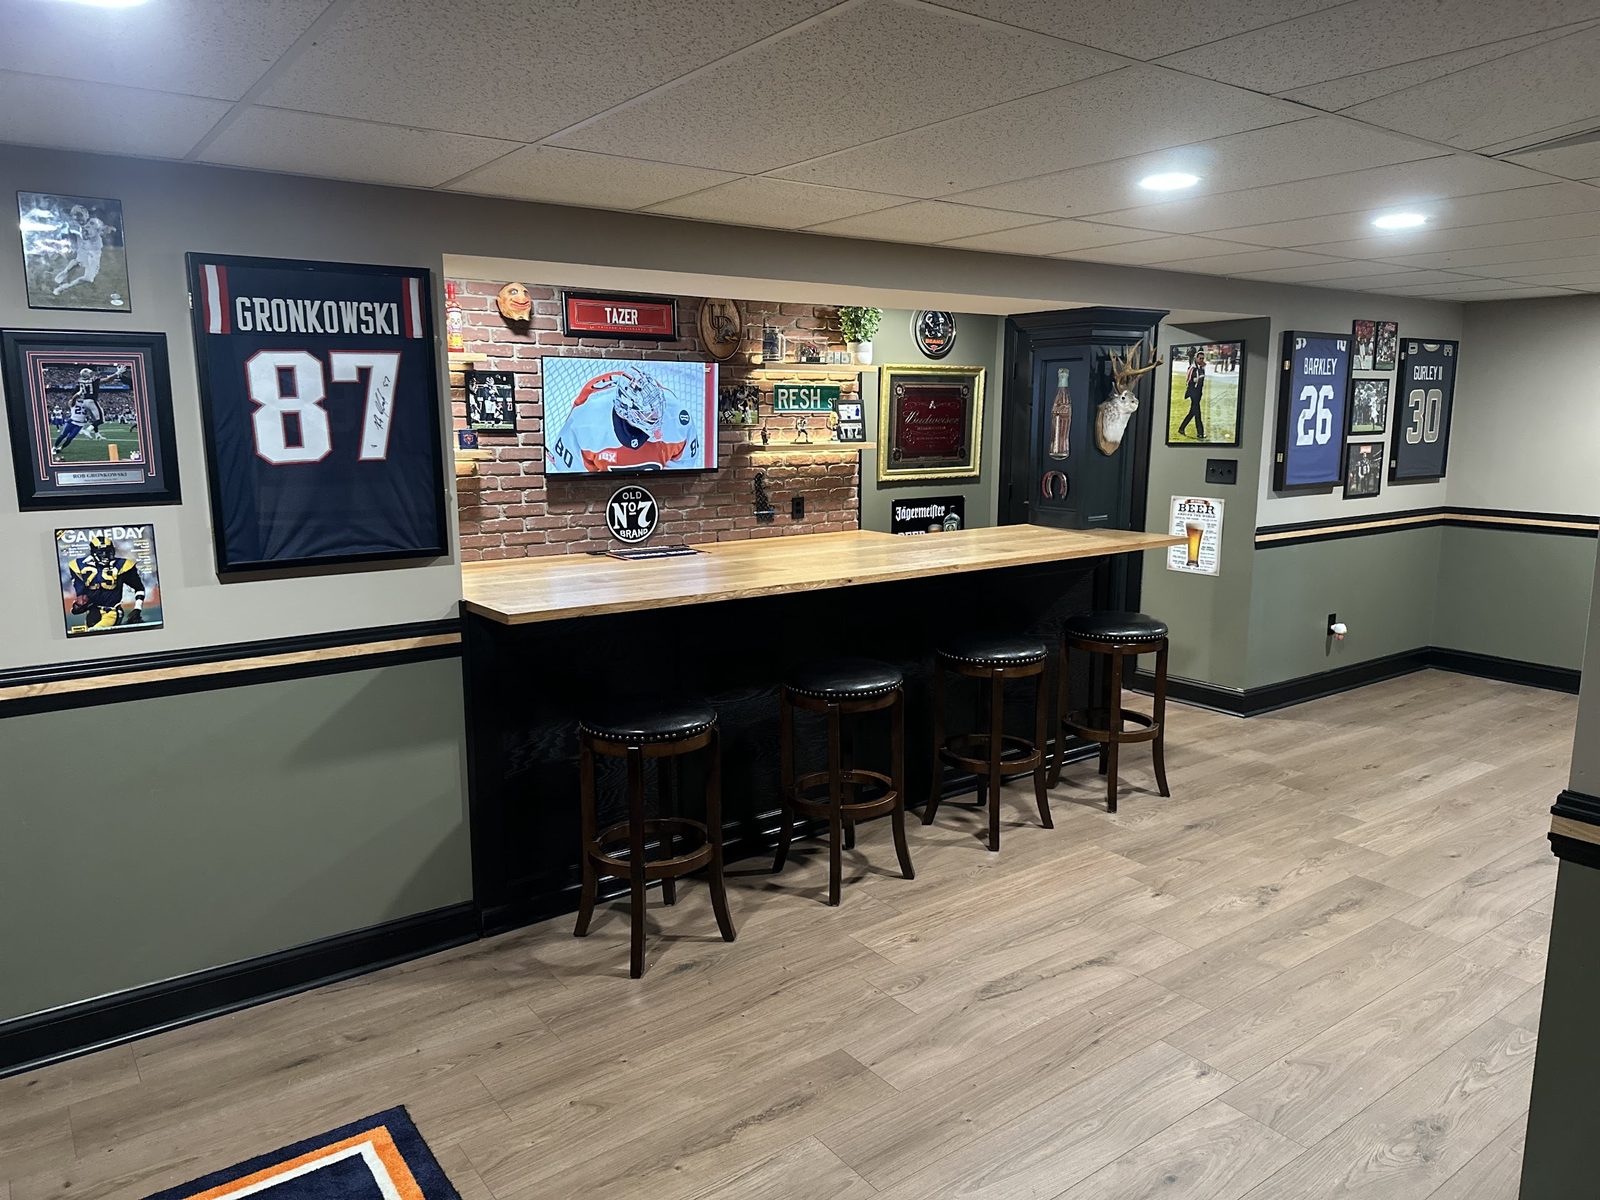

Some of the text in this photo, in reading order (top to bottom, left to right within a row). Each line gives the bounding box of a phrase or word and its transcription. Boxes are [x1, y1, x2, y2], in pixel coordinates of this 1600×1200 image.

[235, 296, 400, 335] GRONKOWSKI
[604, 307, 638, 325] TAZER
[1304, 358, 1338, 376] BARKLEY
[1413, 365, 1438, 381] GURLEY
[243, 349, 402, 466] 87
[778, 388, 820, 409] RESH
[1296, 385, 1334, 446] 26
[1406, 389, 1443, 444] 30
[555, 437, 574, 468] 80
[622, 491, 642, 500] OLD
[1178, 503, 1215, 515] BEER
[619, 528, 648, 539] BRAND
